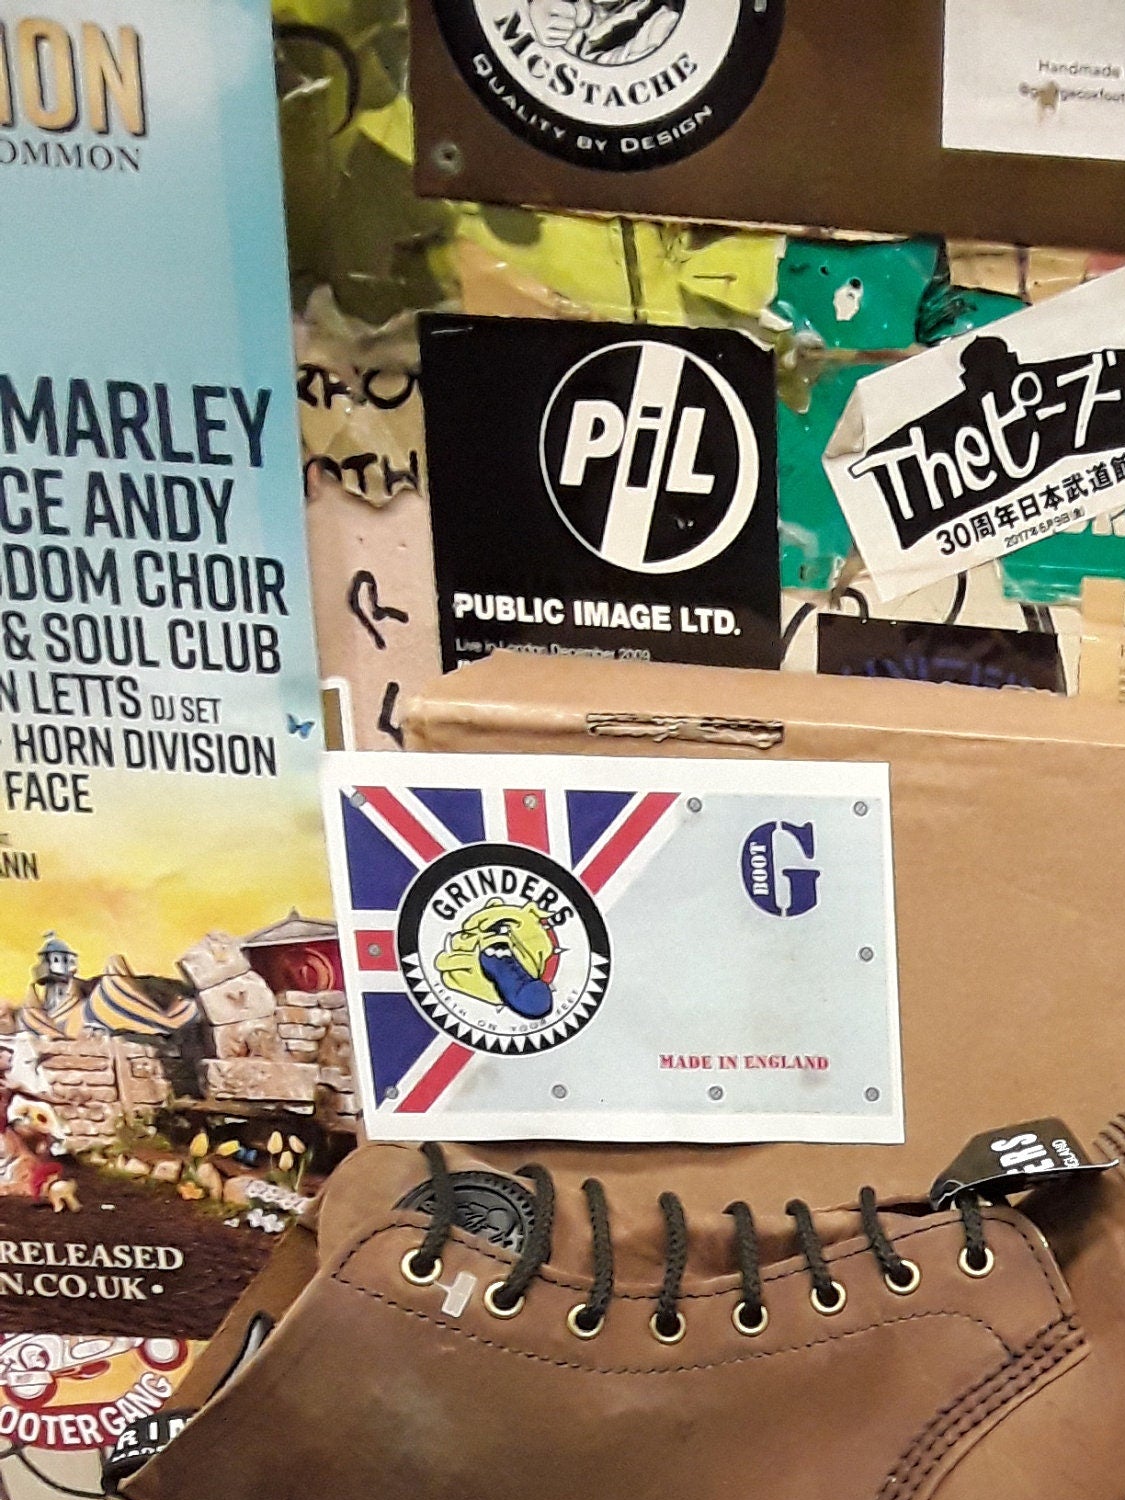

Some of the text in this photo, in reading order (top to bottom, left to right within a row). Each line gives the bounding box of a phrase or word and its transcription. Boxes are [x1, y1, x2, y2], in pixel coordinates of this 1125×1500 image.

[1038, 60, 1121, 79] Handmade
[473, 54, 713, 152] QUALITY BY DESIGN
[0, 373, 273, 468] MARLEY
[560, 399, 716, 494] PiL
[0, 466, 234, 545] CE ANDY
[134, 550, 290, 616] CHOIR
[2, 610, 282, 674] & SOUL CLUB
[453, 592, 741, 636] PUBLIC IMAGE LTD.
[29, 671, 142, 720] LETTS
[152, 694, 174, 722] DJ
[182, 696, 222, 725] SET
[11, 723, 279, 777] HORN DIVISION
[4, 770, 93, 813] FACE
[0, 852, 39, 880] NN
[739, 820, 821, 917] G
[750, 842, 770, 897] BOOT
[432, 867, 574, 929] GRINDERS
[660, 1055, 829, 1071] MADE IN ENGLAND
[0, 1240, 184, 1271] RELEASED
[0, 1372, 173, 1446] OOTER GANG
